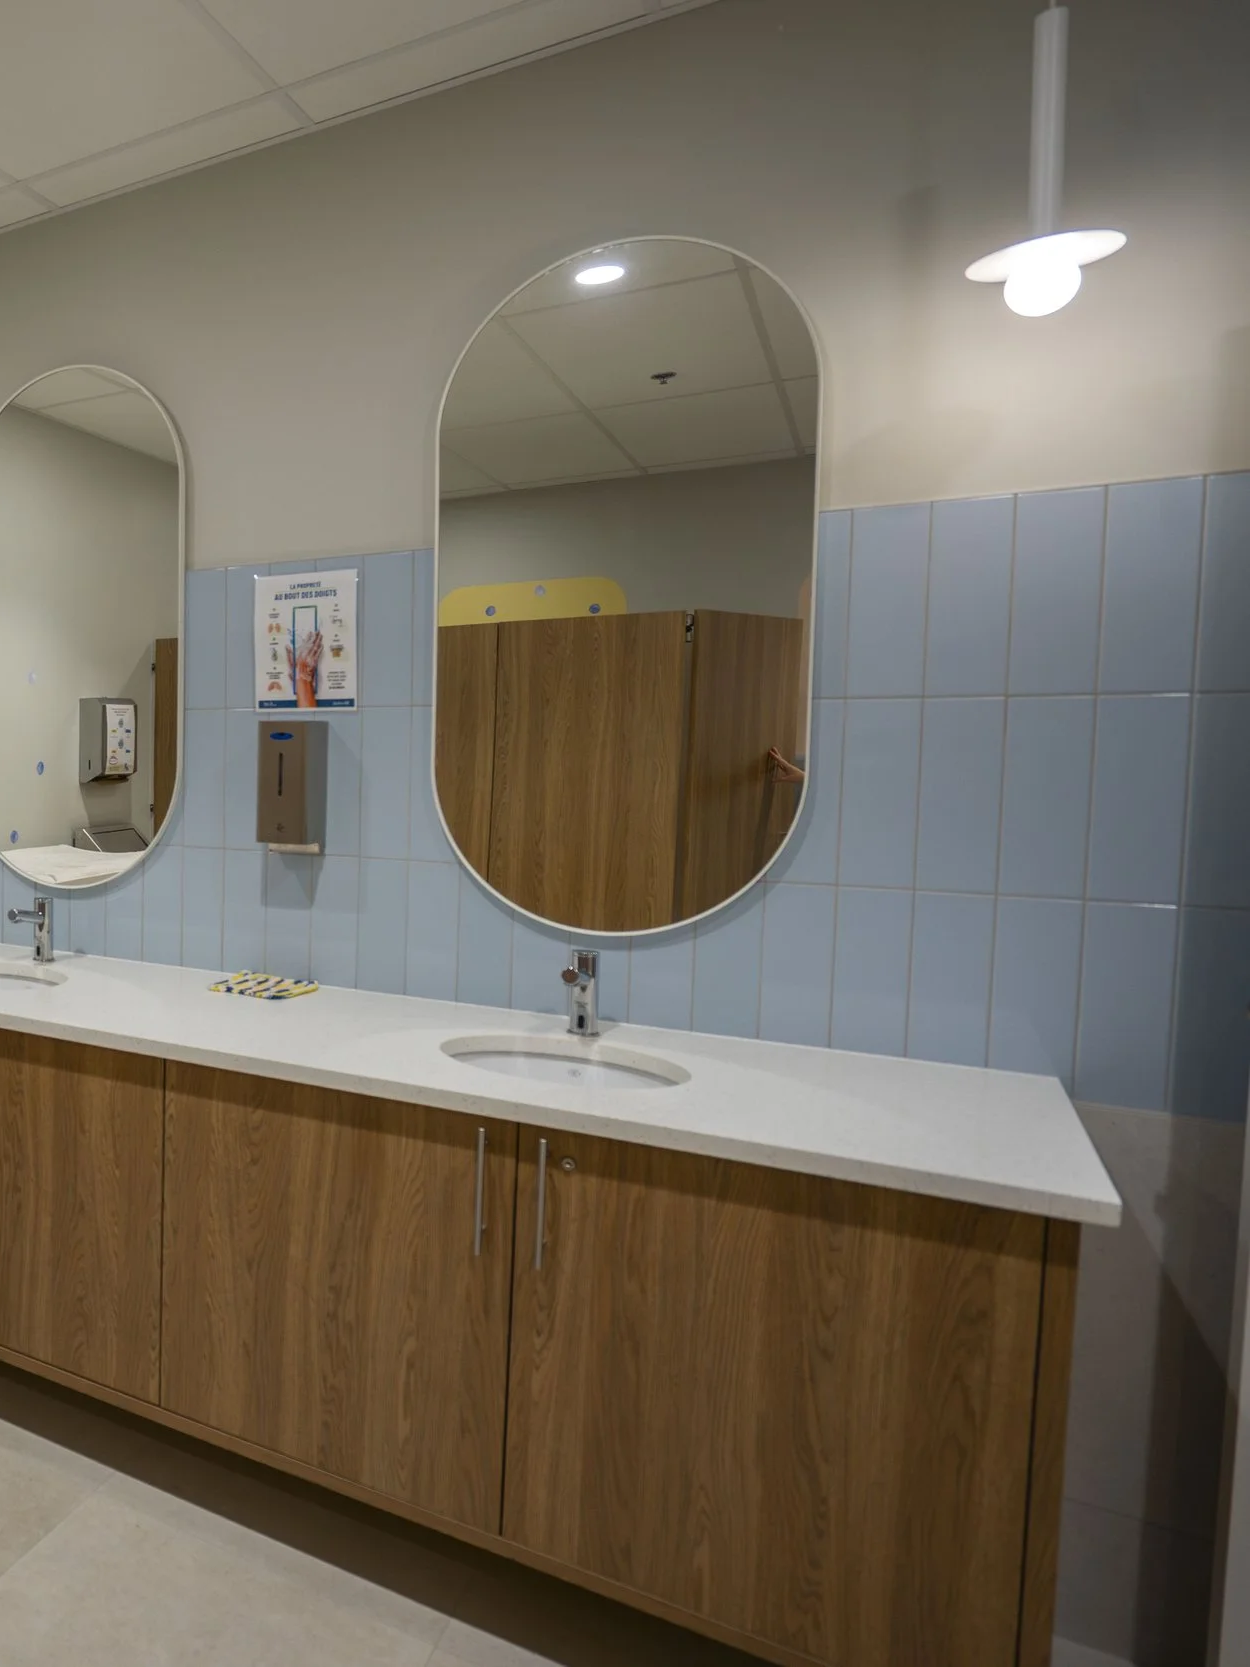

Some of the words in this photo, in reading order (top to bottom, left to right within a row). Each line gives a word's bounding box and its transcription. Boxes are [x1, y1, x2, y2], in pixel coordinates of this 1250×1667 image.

[284, 591, 300, 600] BOUT
[301, 590, 313, 599] DES
[314, 589, 338, 598] DOIGTS
